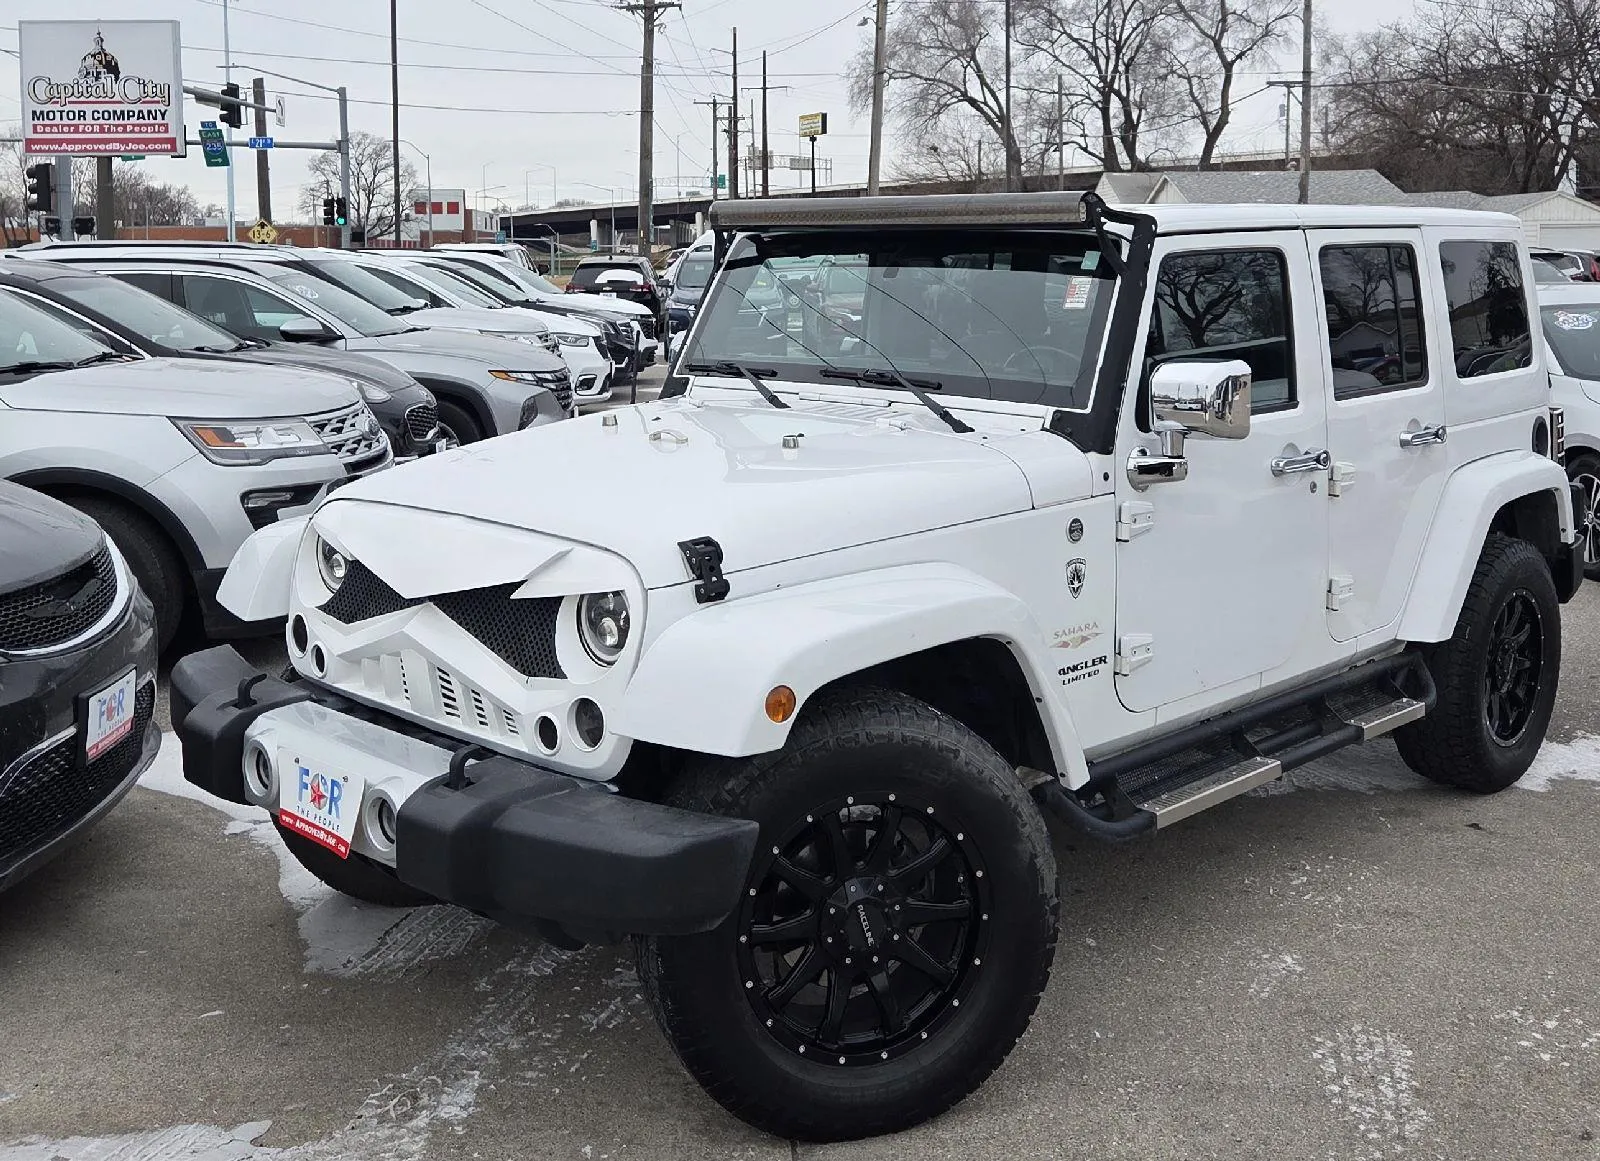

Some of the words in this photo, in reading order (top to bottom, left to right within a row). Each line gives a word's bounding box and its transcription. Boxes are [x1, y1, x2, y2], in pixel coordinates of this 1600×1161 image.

[28, 76, 115, 107] Capital
[118, 76, 171, 107] City
[31, 109, 87, 121] MOTOR
[91, 109, 168, 121] COMPANY
[37, 124, 75, 133] Dealer
[79, 124, 100, 133] FOR
[103, 124, 123, 133] The
[31, 142, 171, 152] www.ApprovedByJoe.com
[1053, 621, 1099, 640] SAHARA
[298, 766, 344, 820] FOR
[313, 813, 341, 833] PEOPLE
[857, 904, 875, 947] RACELINE
